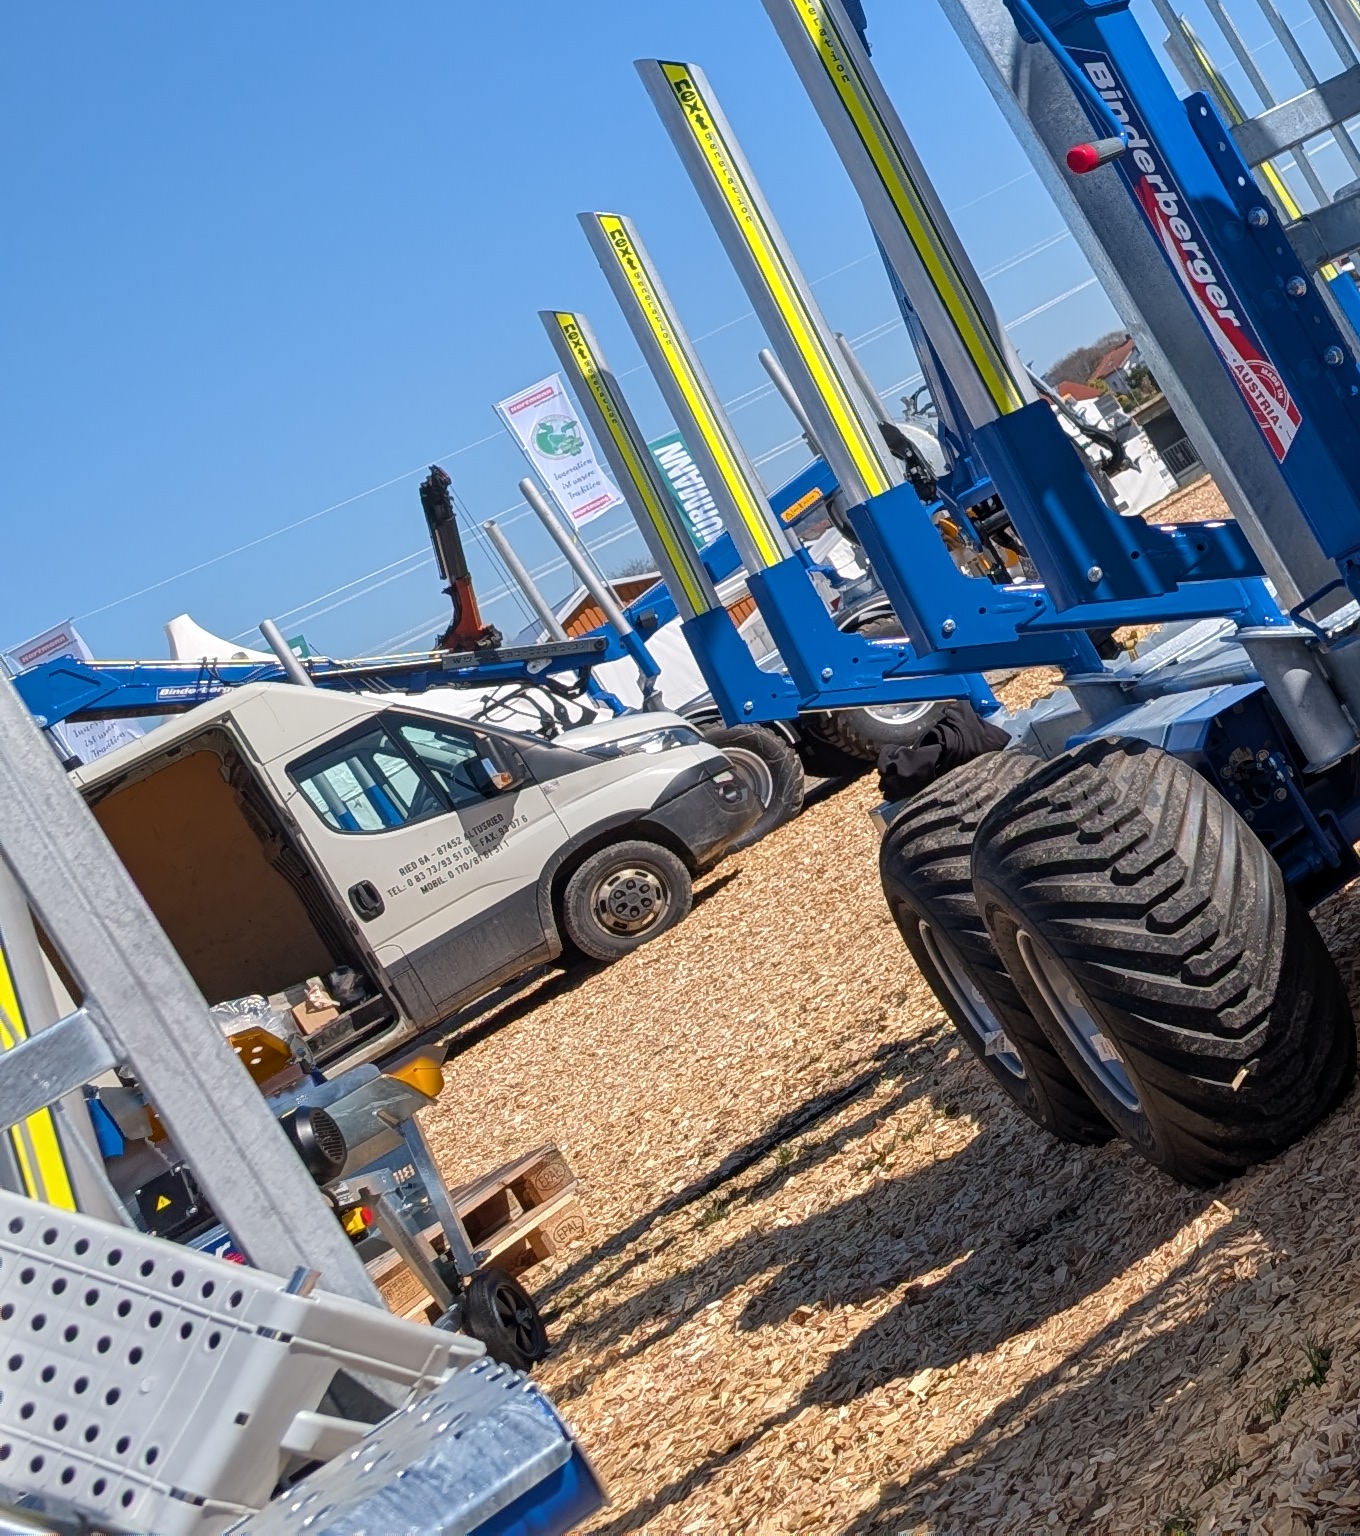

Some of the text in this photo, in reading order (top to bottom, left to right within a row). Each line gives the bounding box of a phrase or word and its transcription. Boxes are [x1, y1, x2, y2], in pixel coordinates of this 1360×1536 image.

[673, 78, 753, 222] next generation
[1084, 61, 1242, 329] Binderberger
[609, 228, 672, 346] next generation
[563, 323, 588, 360] next
[1235, 364, 1281, 427] AUSTRIA
[1260, 367, 1284, 399] MADE IN
[398, 861, 418, 876] RIED
[437, 837, 463, 856] 87452
[464, 813, 504, 841] ALTUSRIED
[453, 850, 463, 862] 51
[556, 1219, 581, 1240] EPAL
